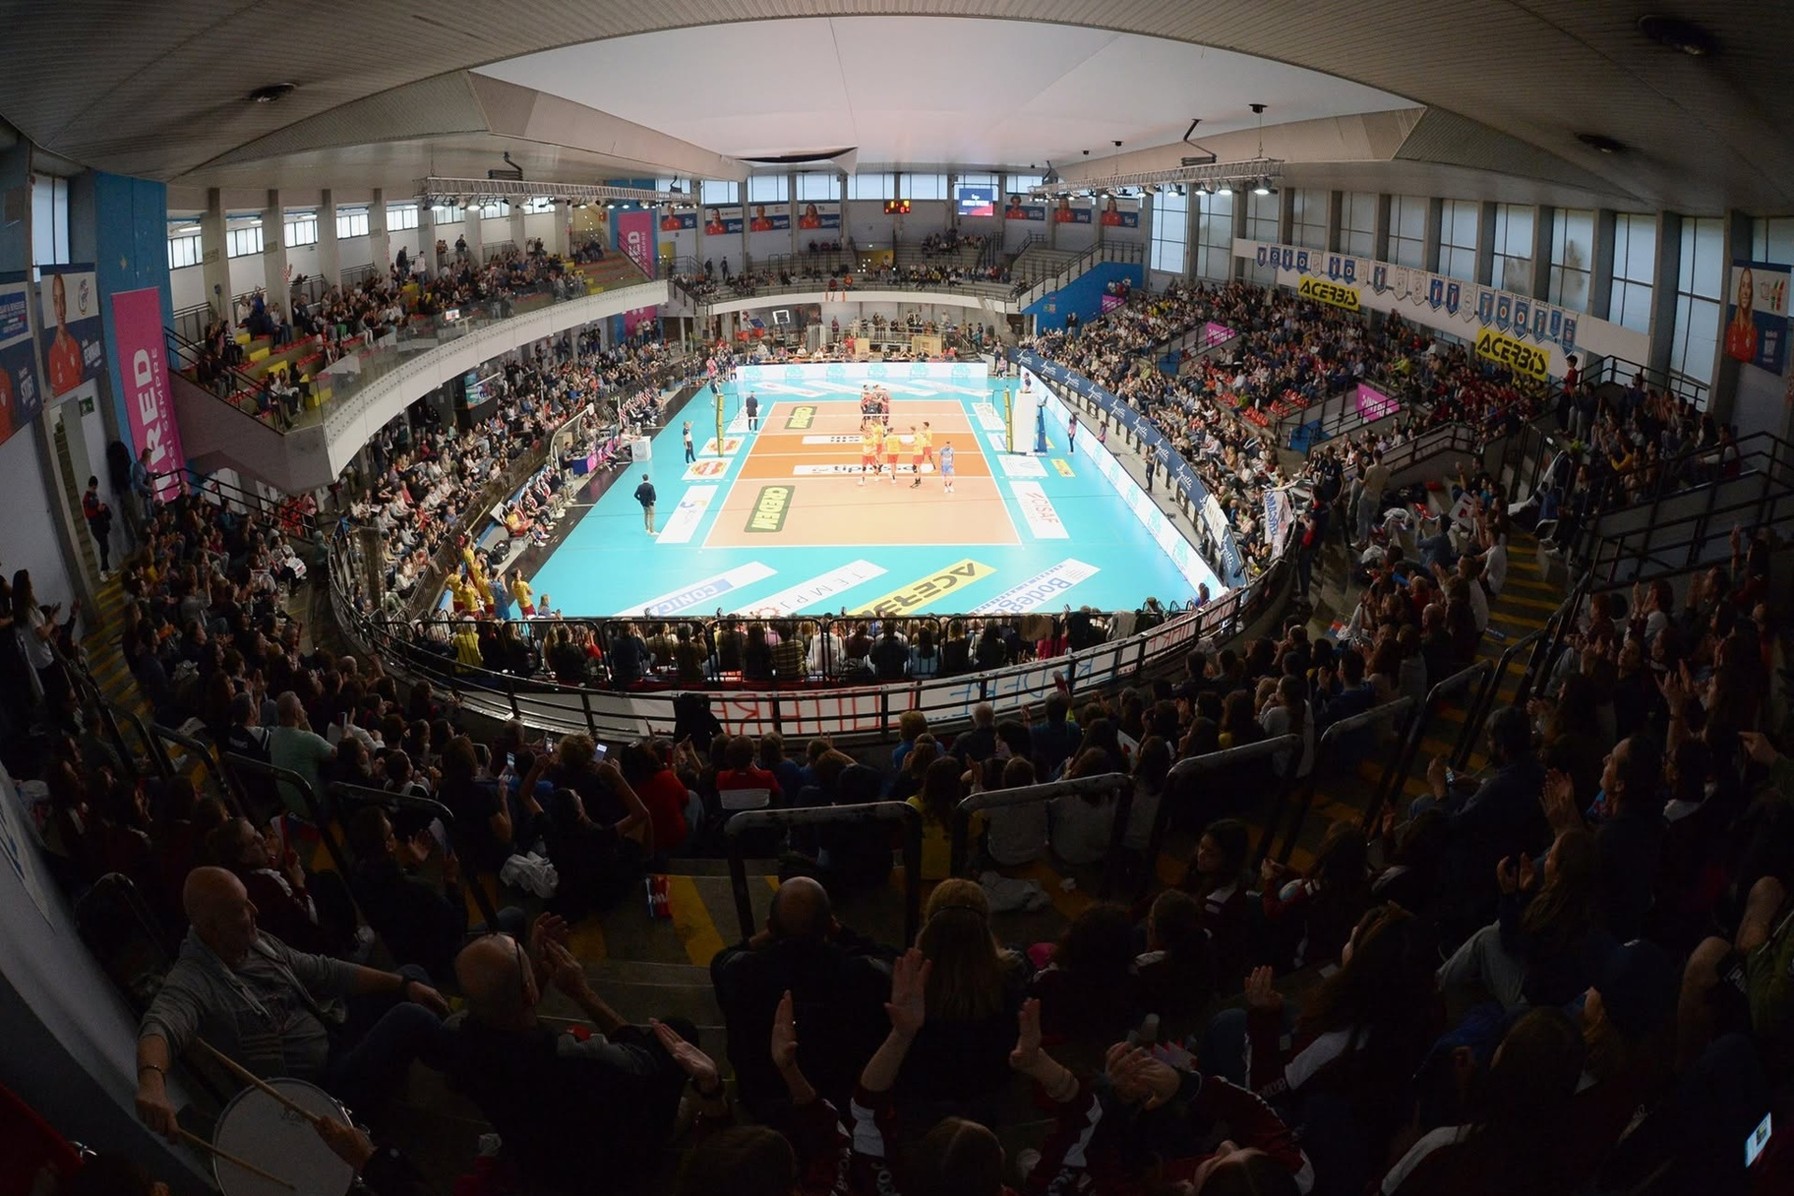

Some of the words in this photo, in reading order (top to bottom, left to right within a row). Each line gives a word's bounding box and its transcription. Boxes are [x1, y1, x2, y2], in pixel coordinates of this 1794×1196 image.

[1300, 280, 1358, 306] ACERBIS
[1477, 333, 1547, 375] ACERBIS
[133, 348, 172, 506] TRED
[751, 487, 788, 530] CREDEM
[866, 562, 976, 615] ACERB
